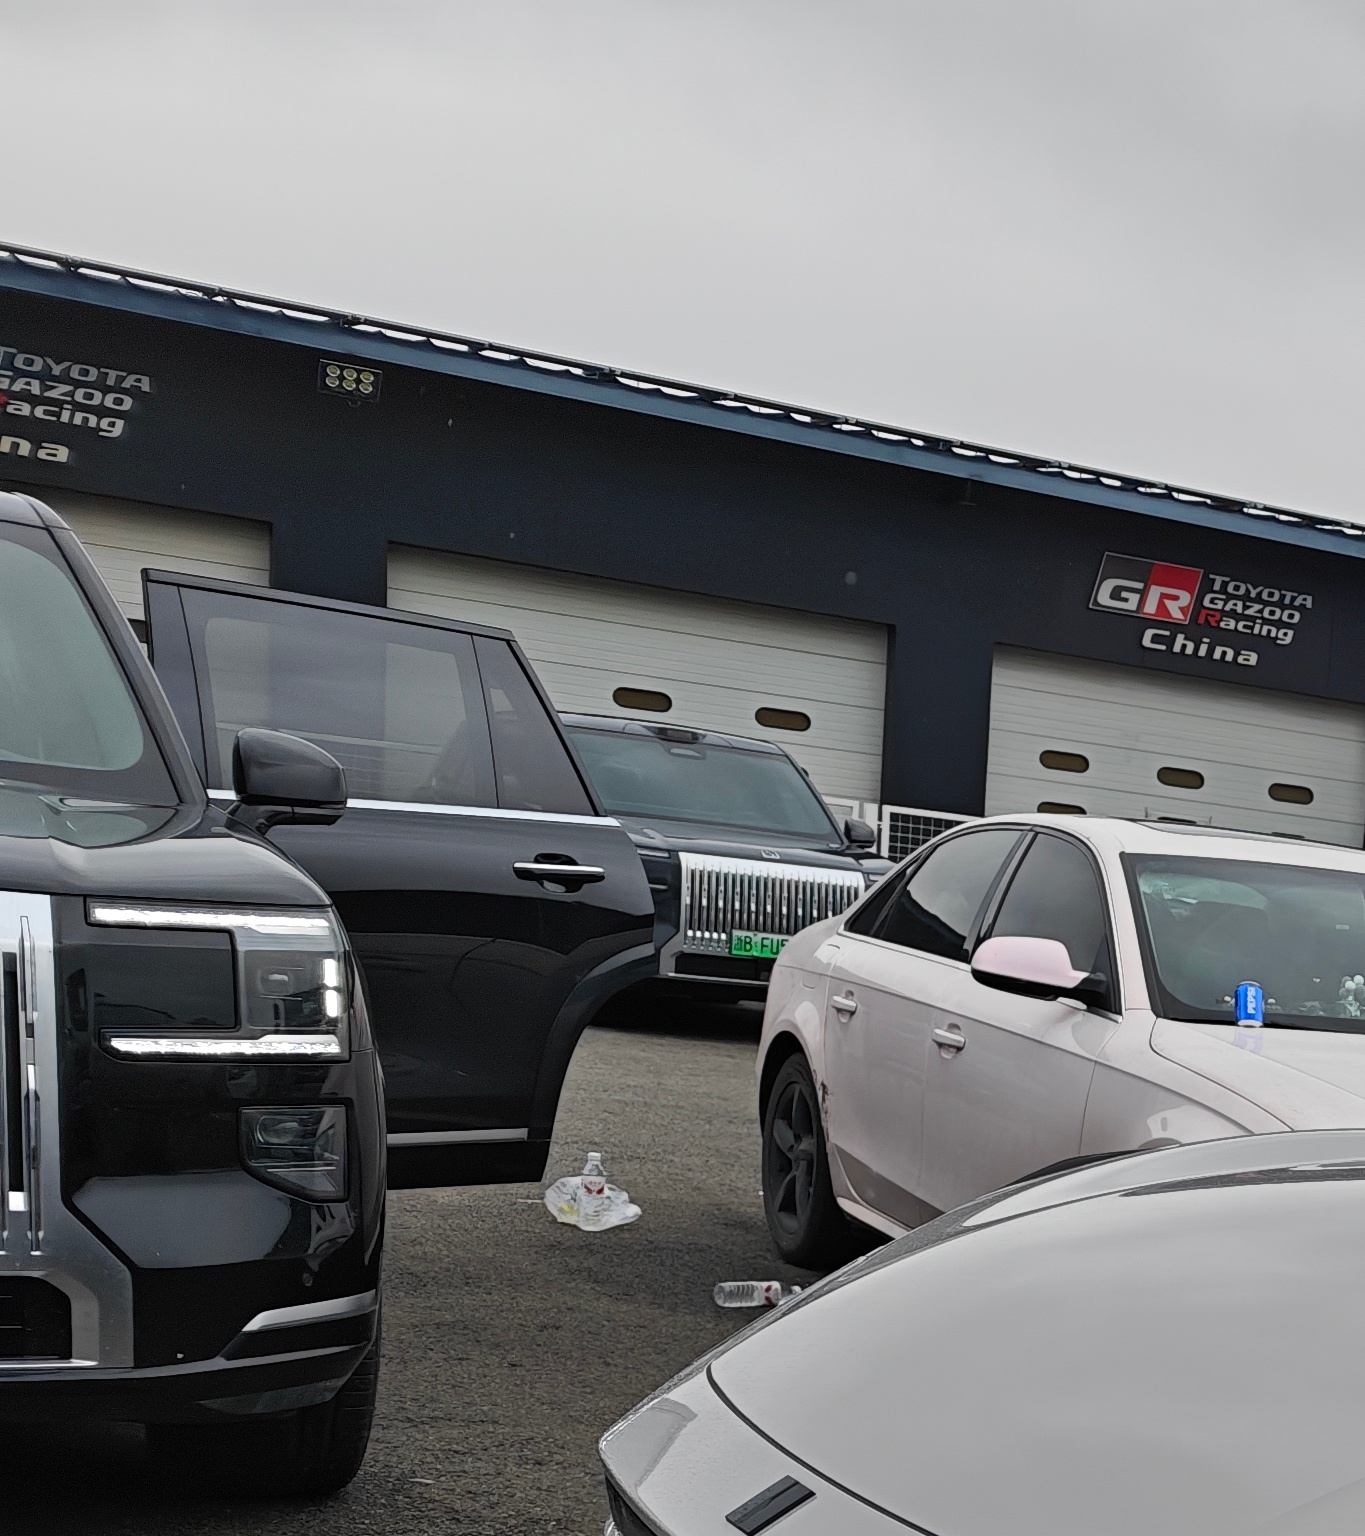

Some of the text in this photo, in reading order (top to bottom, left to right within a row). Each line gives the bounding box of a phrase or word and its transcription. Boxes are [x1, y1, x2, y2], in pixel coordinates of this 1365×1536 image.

[0, 394, 125, 438] acing
[1096, 578, 1191, 621] GR
[1202, 593, 1301, 624] GAZOO
[1208, 574, 1313, 609] TOYOTA
[1197, 609, 1295, 645] Racing
[1141, 628, 1259, 666] China
